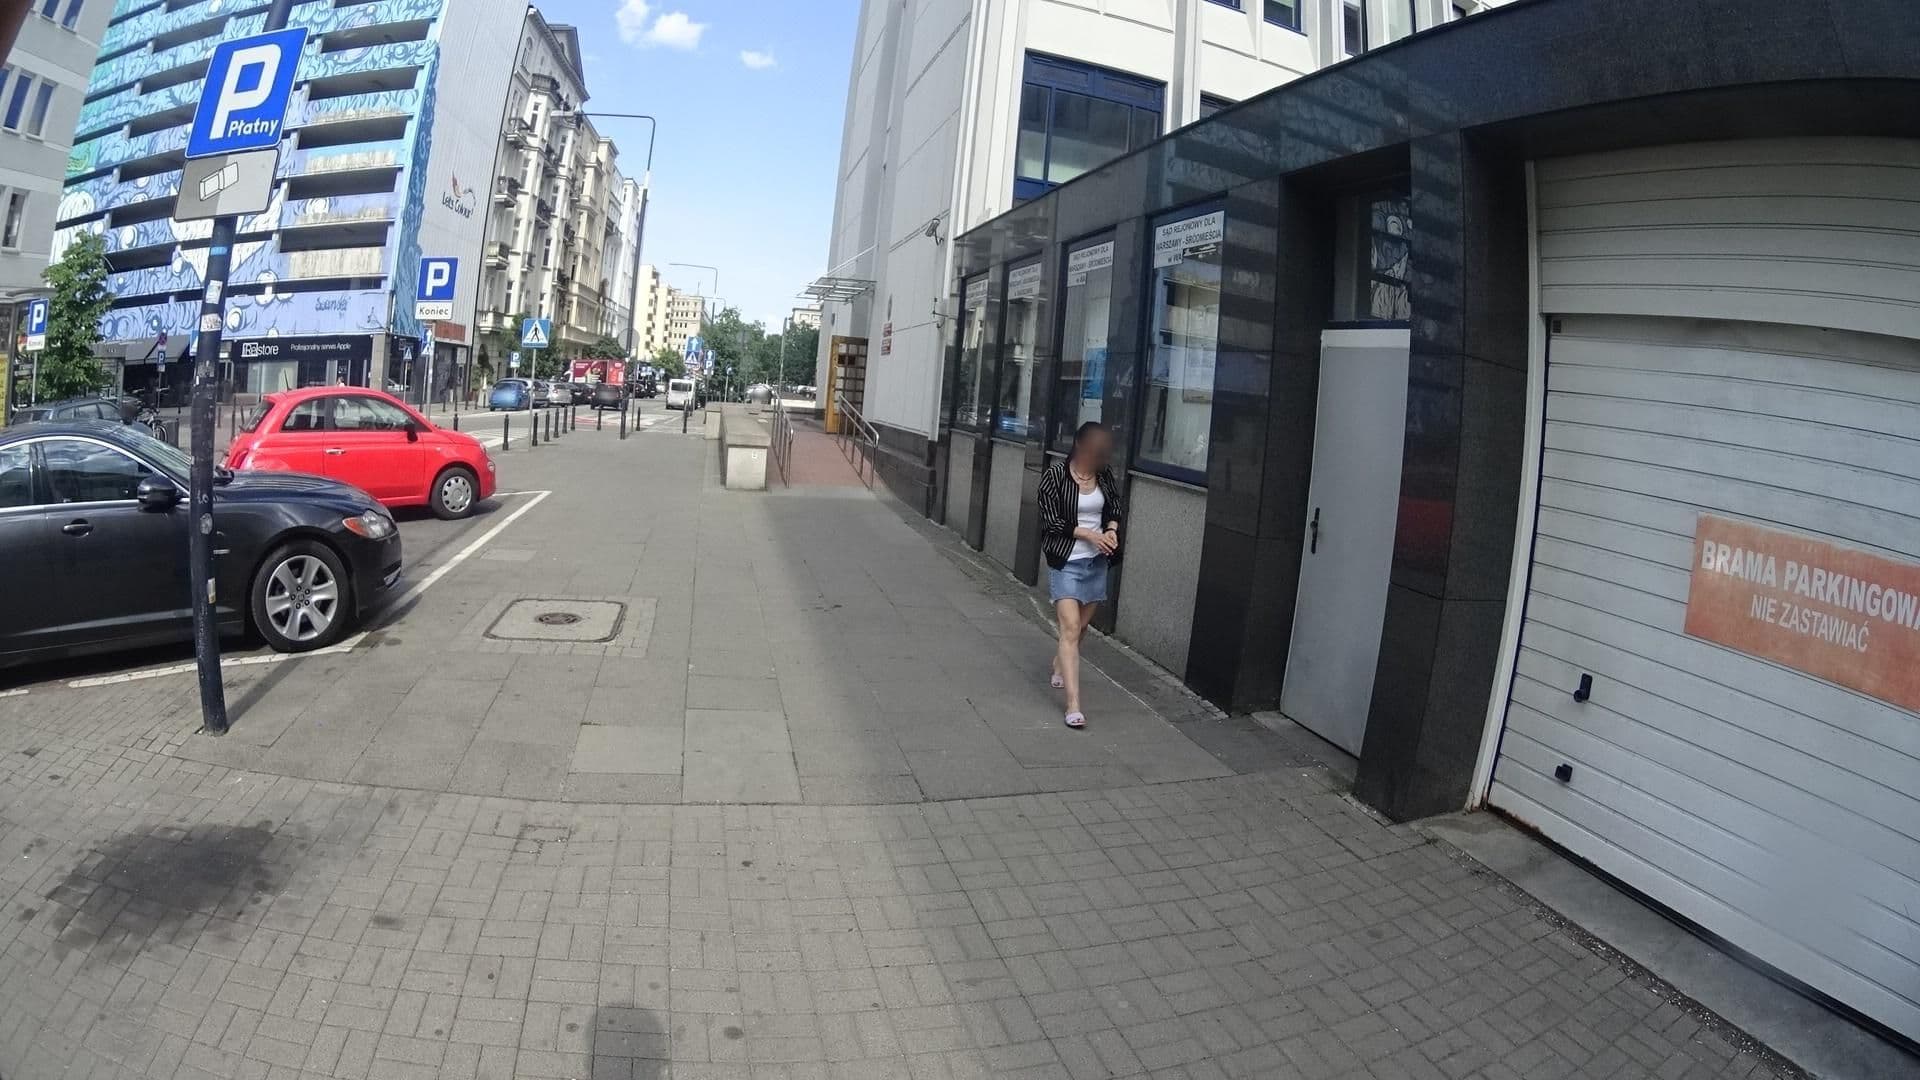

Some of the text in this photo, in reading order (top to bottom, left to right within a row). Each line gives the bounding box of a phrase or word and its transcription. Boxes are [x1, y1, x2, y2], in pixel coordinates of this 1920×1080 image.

[209, 43, 282, 140] P
[228, 117, 280, 138] Płatny
[1204, 216, 1216, 227] DLA
[425, 262, 450, 297] P
[31, 303, 45, 332] P
[419, 306, 449, 315] Koniec
[337, 342, 352, 351] Apple
[159, 352, 165, 363] P
[512, 352, 520, 360] P
[706, 360, 713, 368] P
[1701, 540, 1777, 588] BRAMA
[1750, 594, 1870, 652] NIE ZASTAWIAĆ
